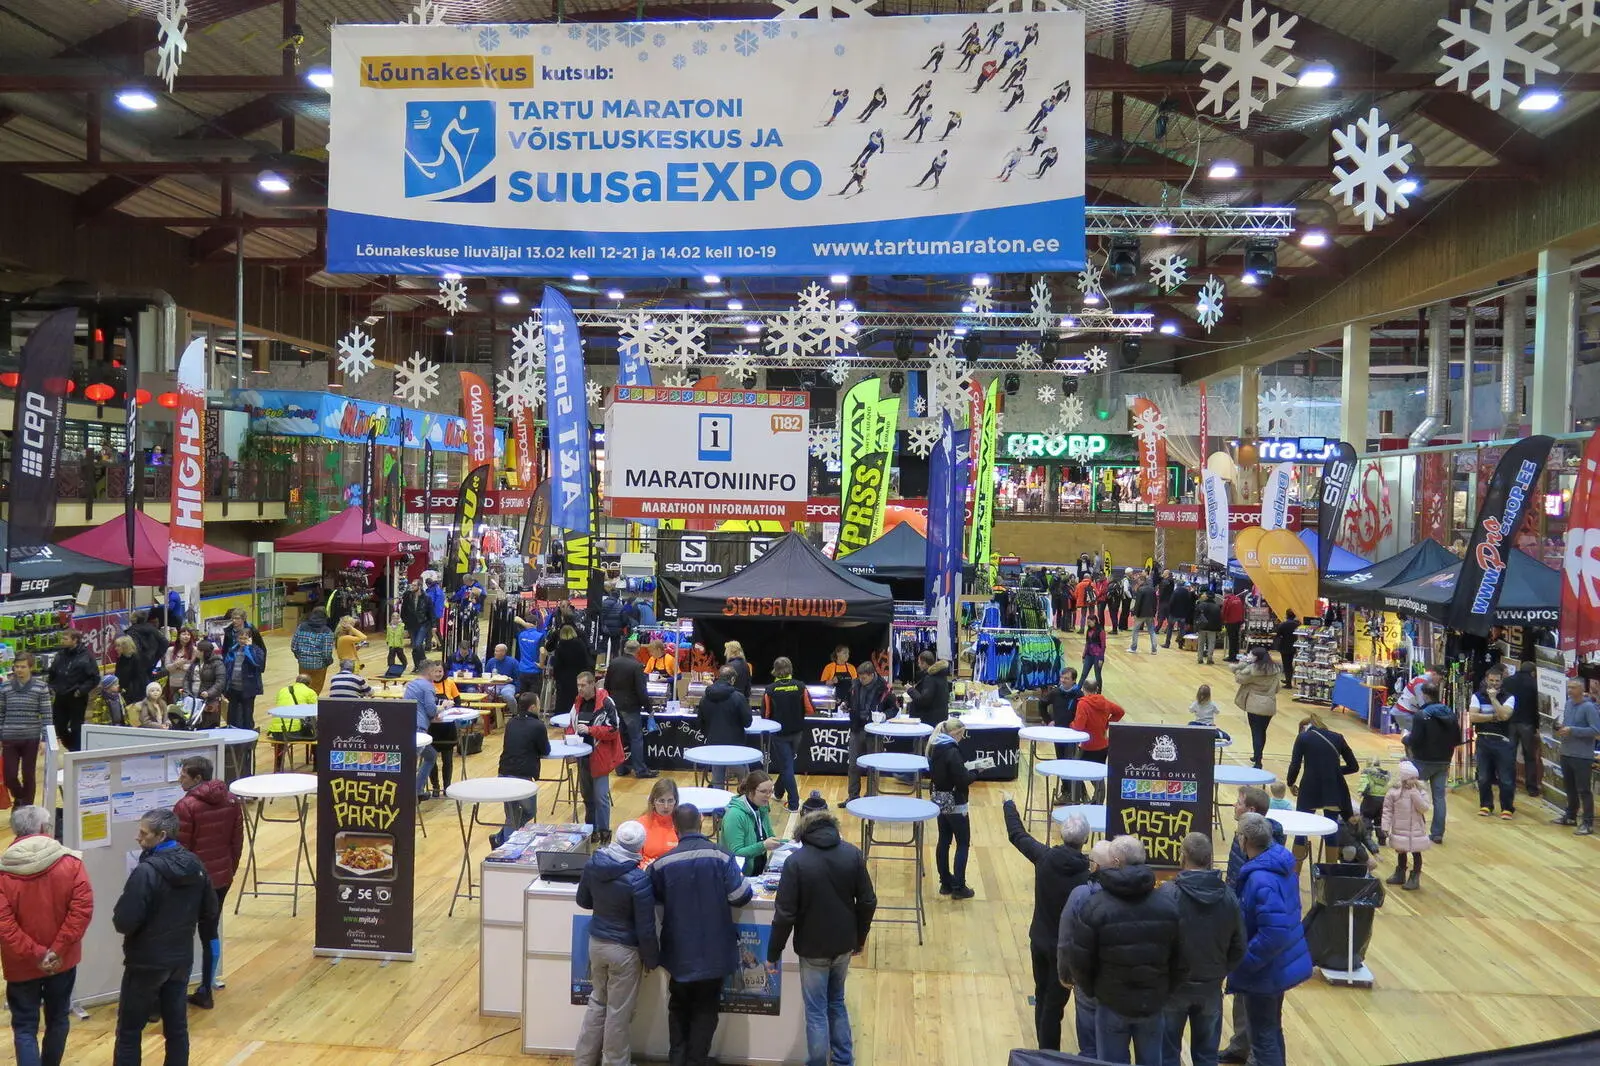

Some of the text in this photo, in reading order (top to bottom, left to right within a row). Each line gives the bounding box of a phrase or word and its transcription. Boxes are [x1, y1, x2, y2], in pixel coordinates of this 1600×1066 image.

[366, 61, 614, 83] Lõunakeskus kutsub:
[508, 98, 743, 121] TARTU MARATONI
[508, 127, 783, 151] VÕISTLUSKESKUS JA
[508, 159, 823, 204] suusaEXPO
[356, 243, 777, 262] Lõunakeskuse liuväljal 13.02 kell 12-21 ja 14.02 kell 10-19
[812, 237, 1060, 257] www.tartumaraton.ee
[24, 391, 53, 449] cep
[774, 415, 801, 430] 1182
[625, 469, 797, 491] MARATONIINFO
[641, 501, 786, 516] MARATHON INFORMATION
[31, 578, 50, 592] cep
[1385, 597, 1428, 614] www.proshop.ee
[333, 742, 367, 750] TERVISE
[810, 746, 849, 764] PART
[330, 777, 398, 805] PASTA
[334, 803, 400, 830] PARTY
[1120, 807, 1194, 836] PASTA
[357, 888, 373, 900] 5€
